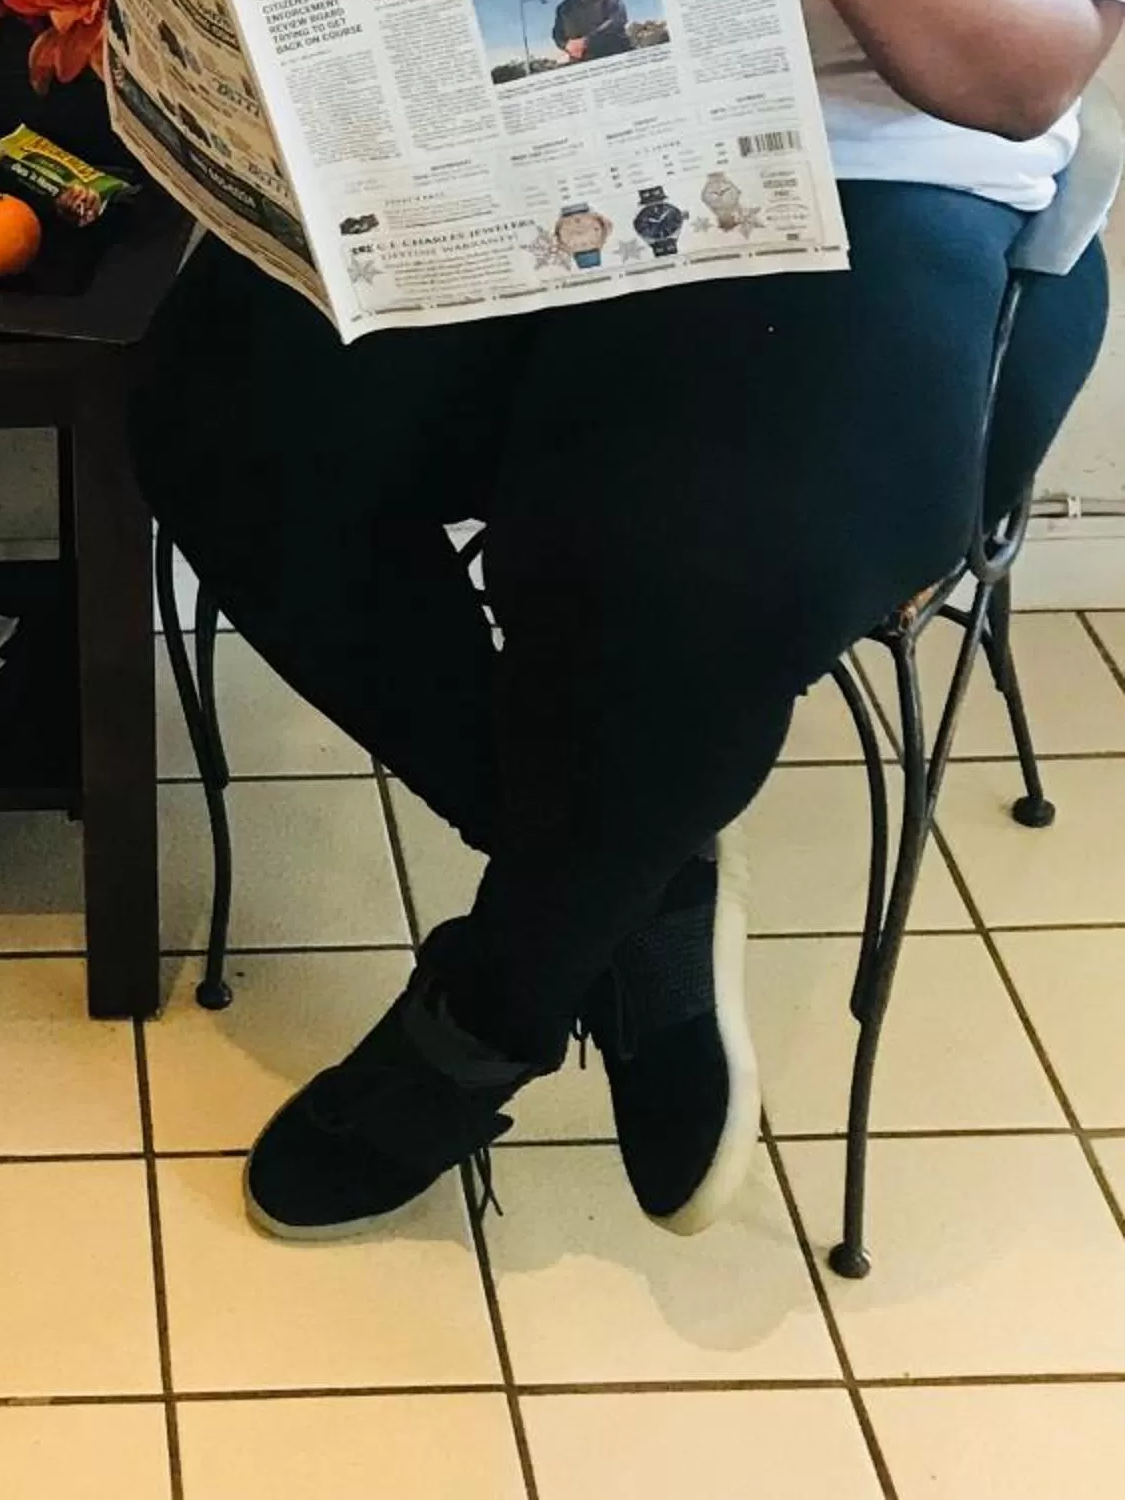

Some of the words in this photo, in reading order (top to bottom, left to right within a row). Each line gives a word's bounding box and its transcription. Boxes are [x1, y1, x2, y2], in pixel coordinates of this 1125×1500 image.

[269, 18, 308, 34] REVIEW
[312, 23, 325, 34] TO
[327, 18, 347, 31] GET
[306, 35, 321, 47] ON
[322, 23, 364, 42] COURSE
